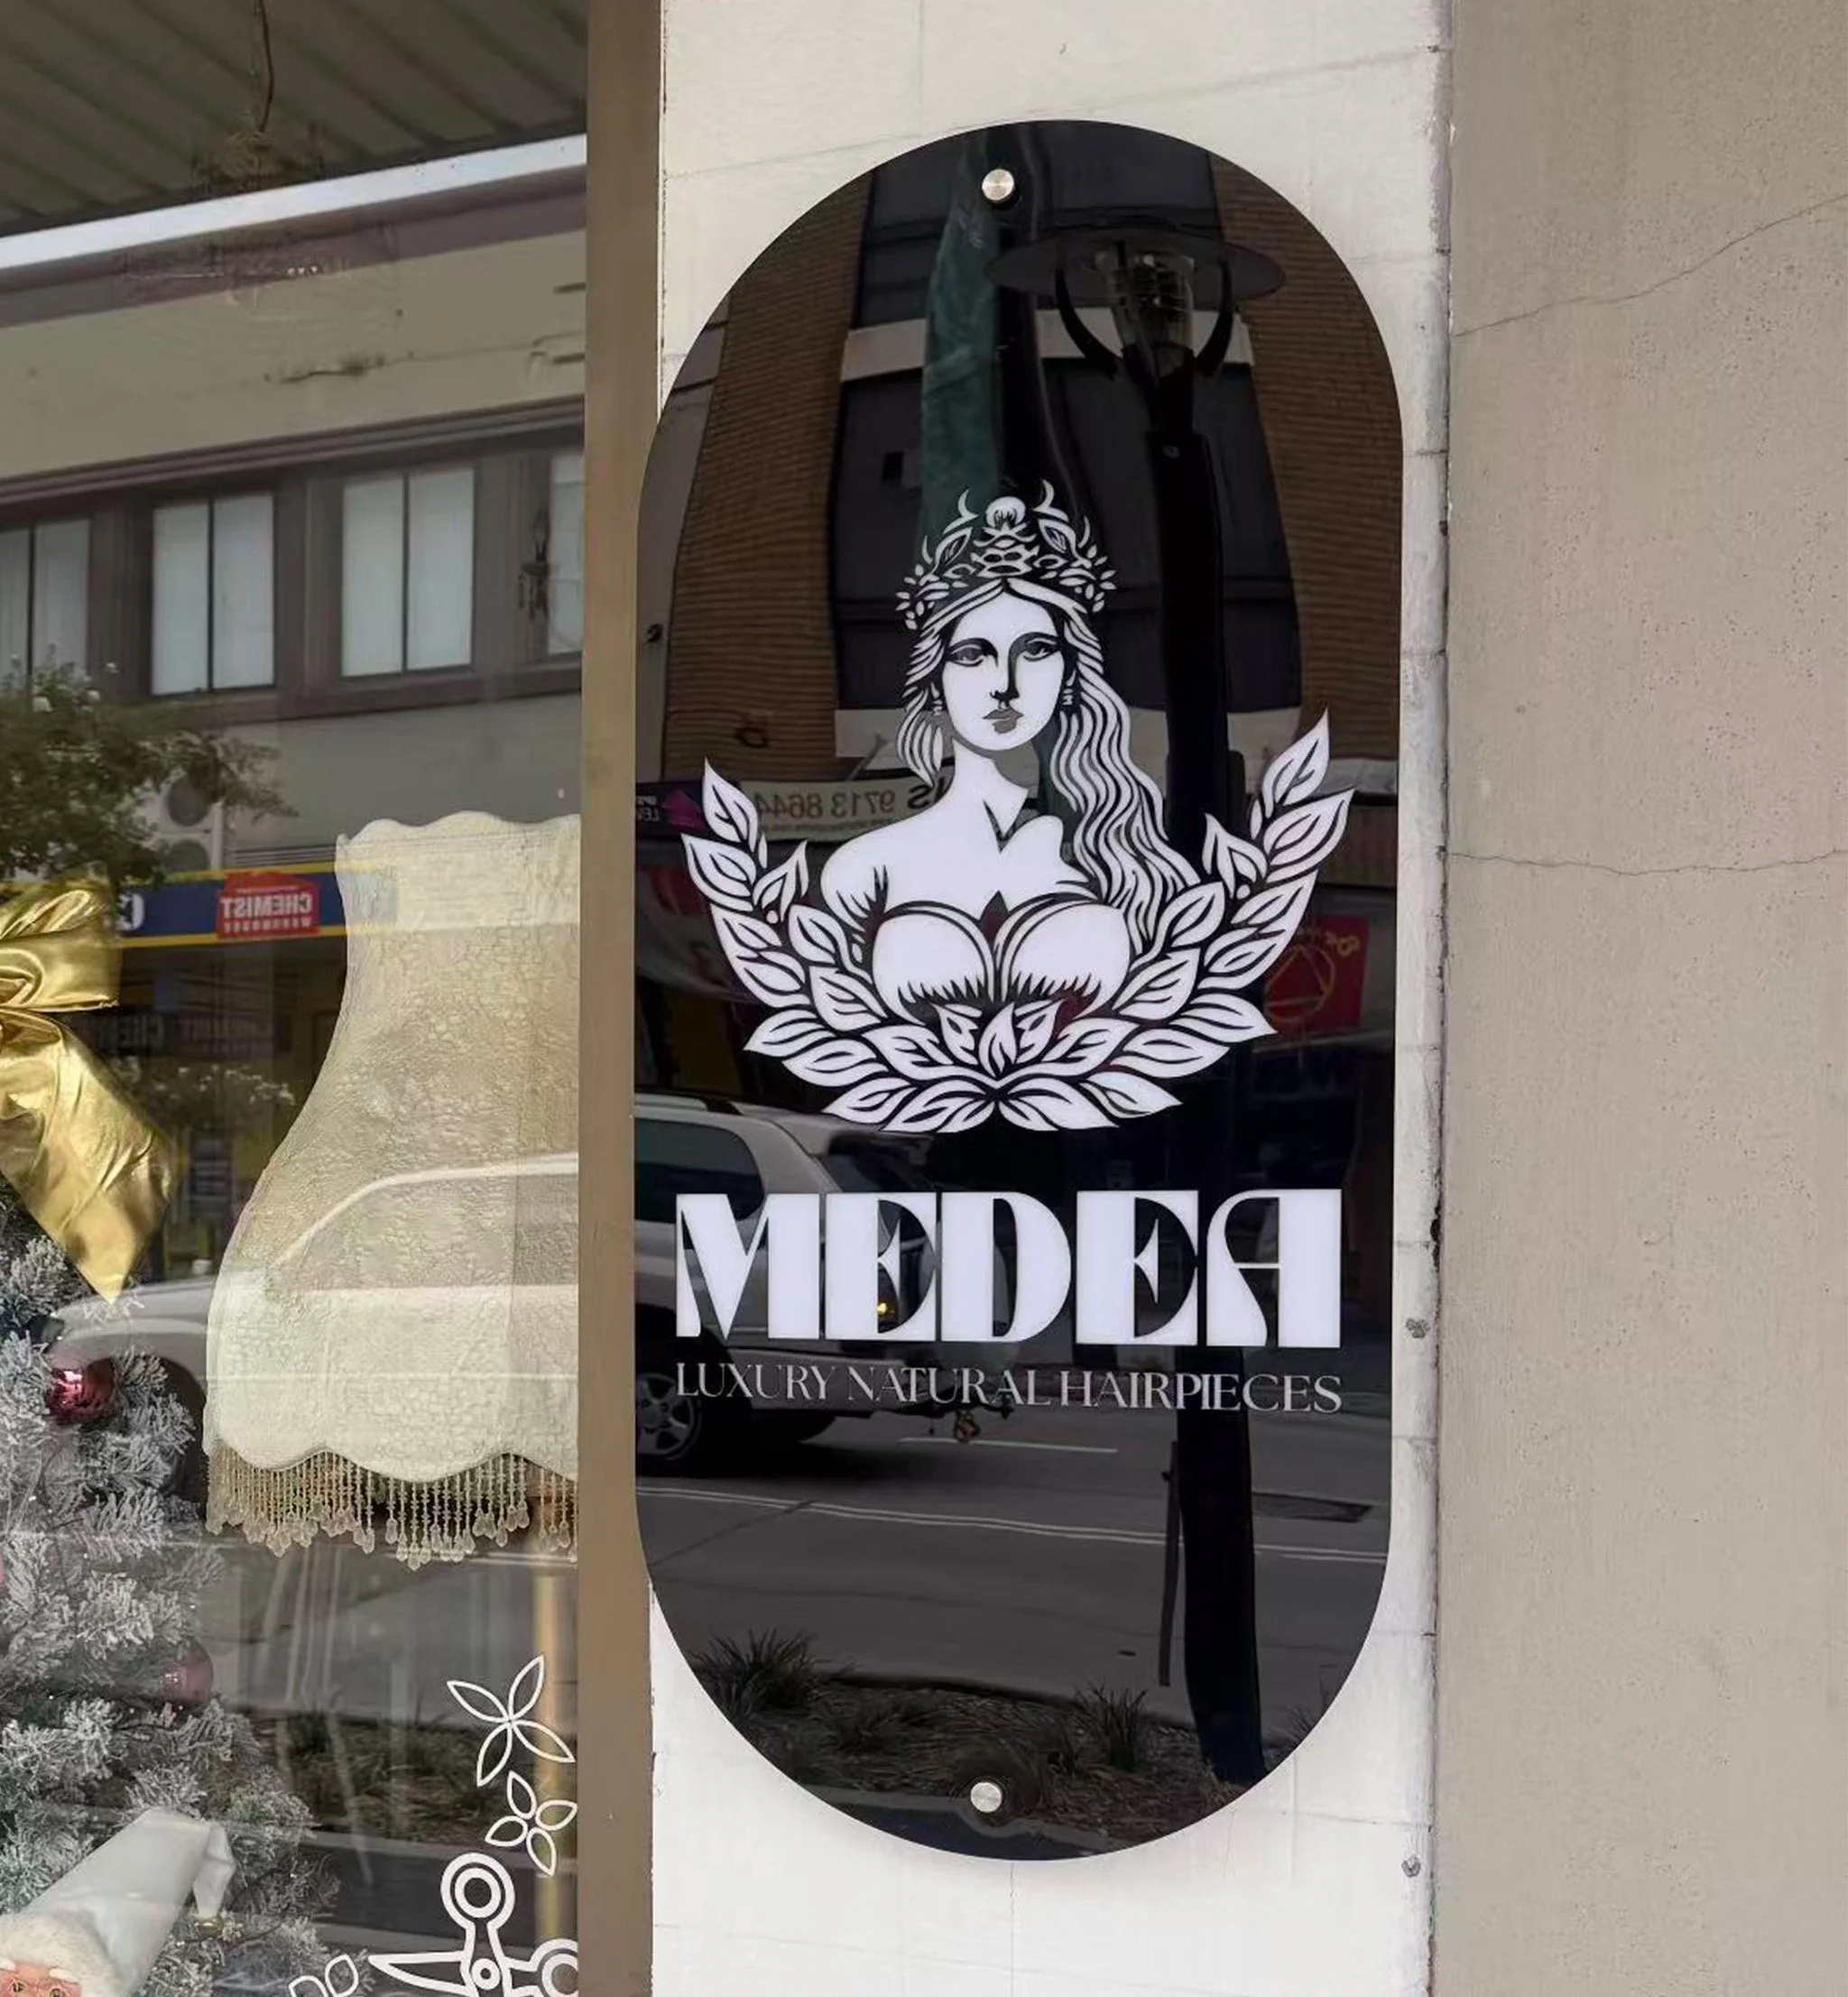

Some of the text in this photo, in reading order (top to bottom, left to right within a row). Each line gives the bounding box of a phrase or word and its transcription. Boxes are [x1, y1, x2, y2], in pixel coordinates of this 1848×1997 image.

[676, 1188, 1342, 1348] MEDEA
[677, 1362, 1343, 1413] LUXURY NATURAL HAIRPIECES
